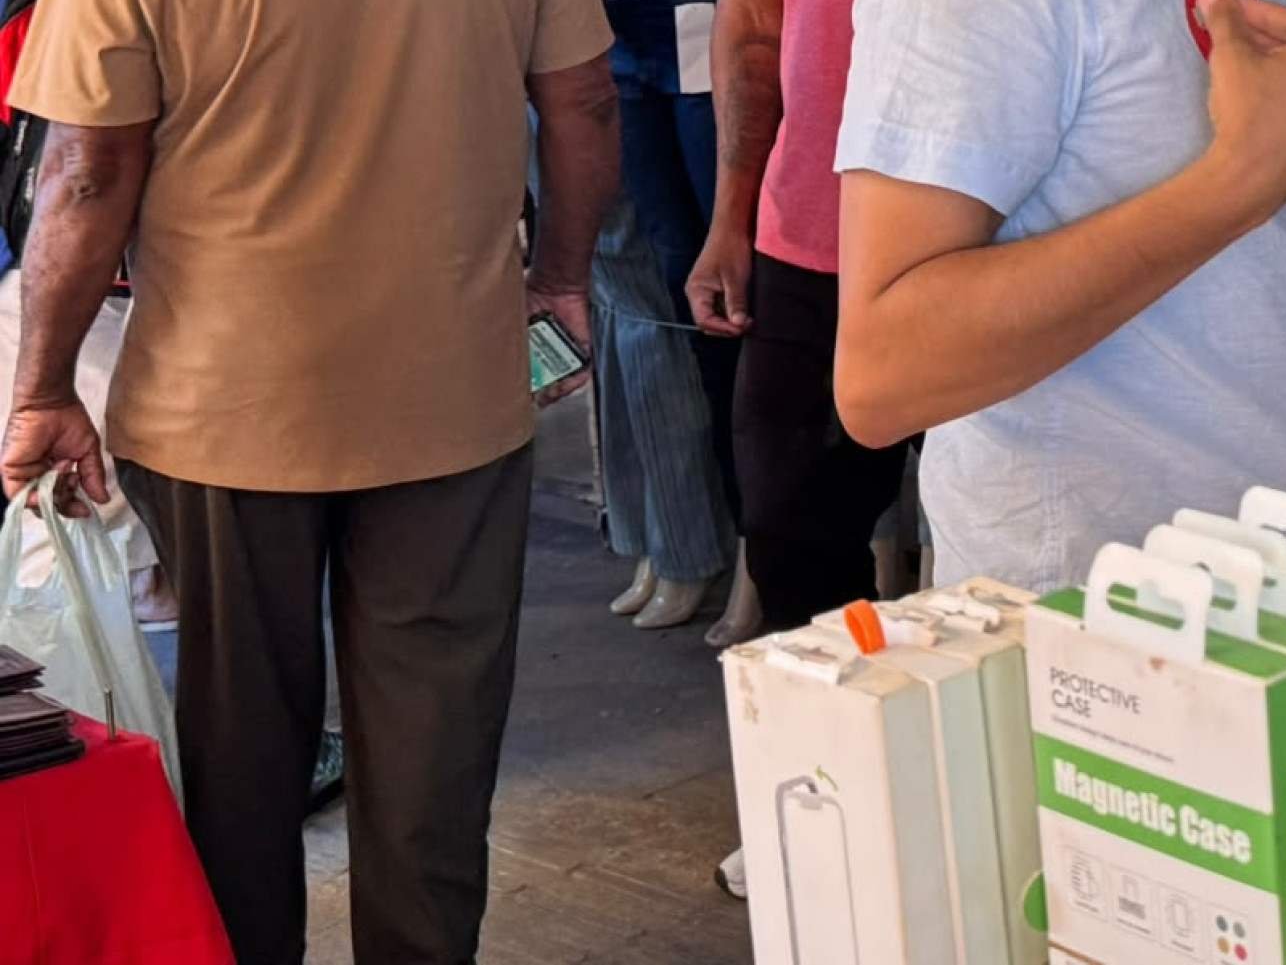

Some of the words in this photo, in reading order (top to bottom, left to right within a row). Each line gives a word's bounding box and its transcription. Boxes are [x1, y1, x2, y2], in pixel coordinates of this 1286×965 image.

[1050, 667, 1142, 715] PROTECTIVE
[1051, 688, 1092, 718] CASE
[1053, 756, 1177, 837] Magnetic
[1178, 803, 1252, 864] Case
